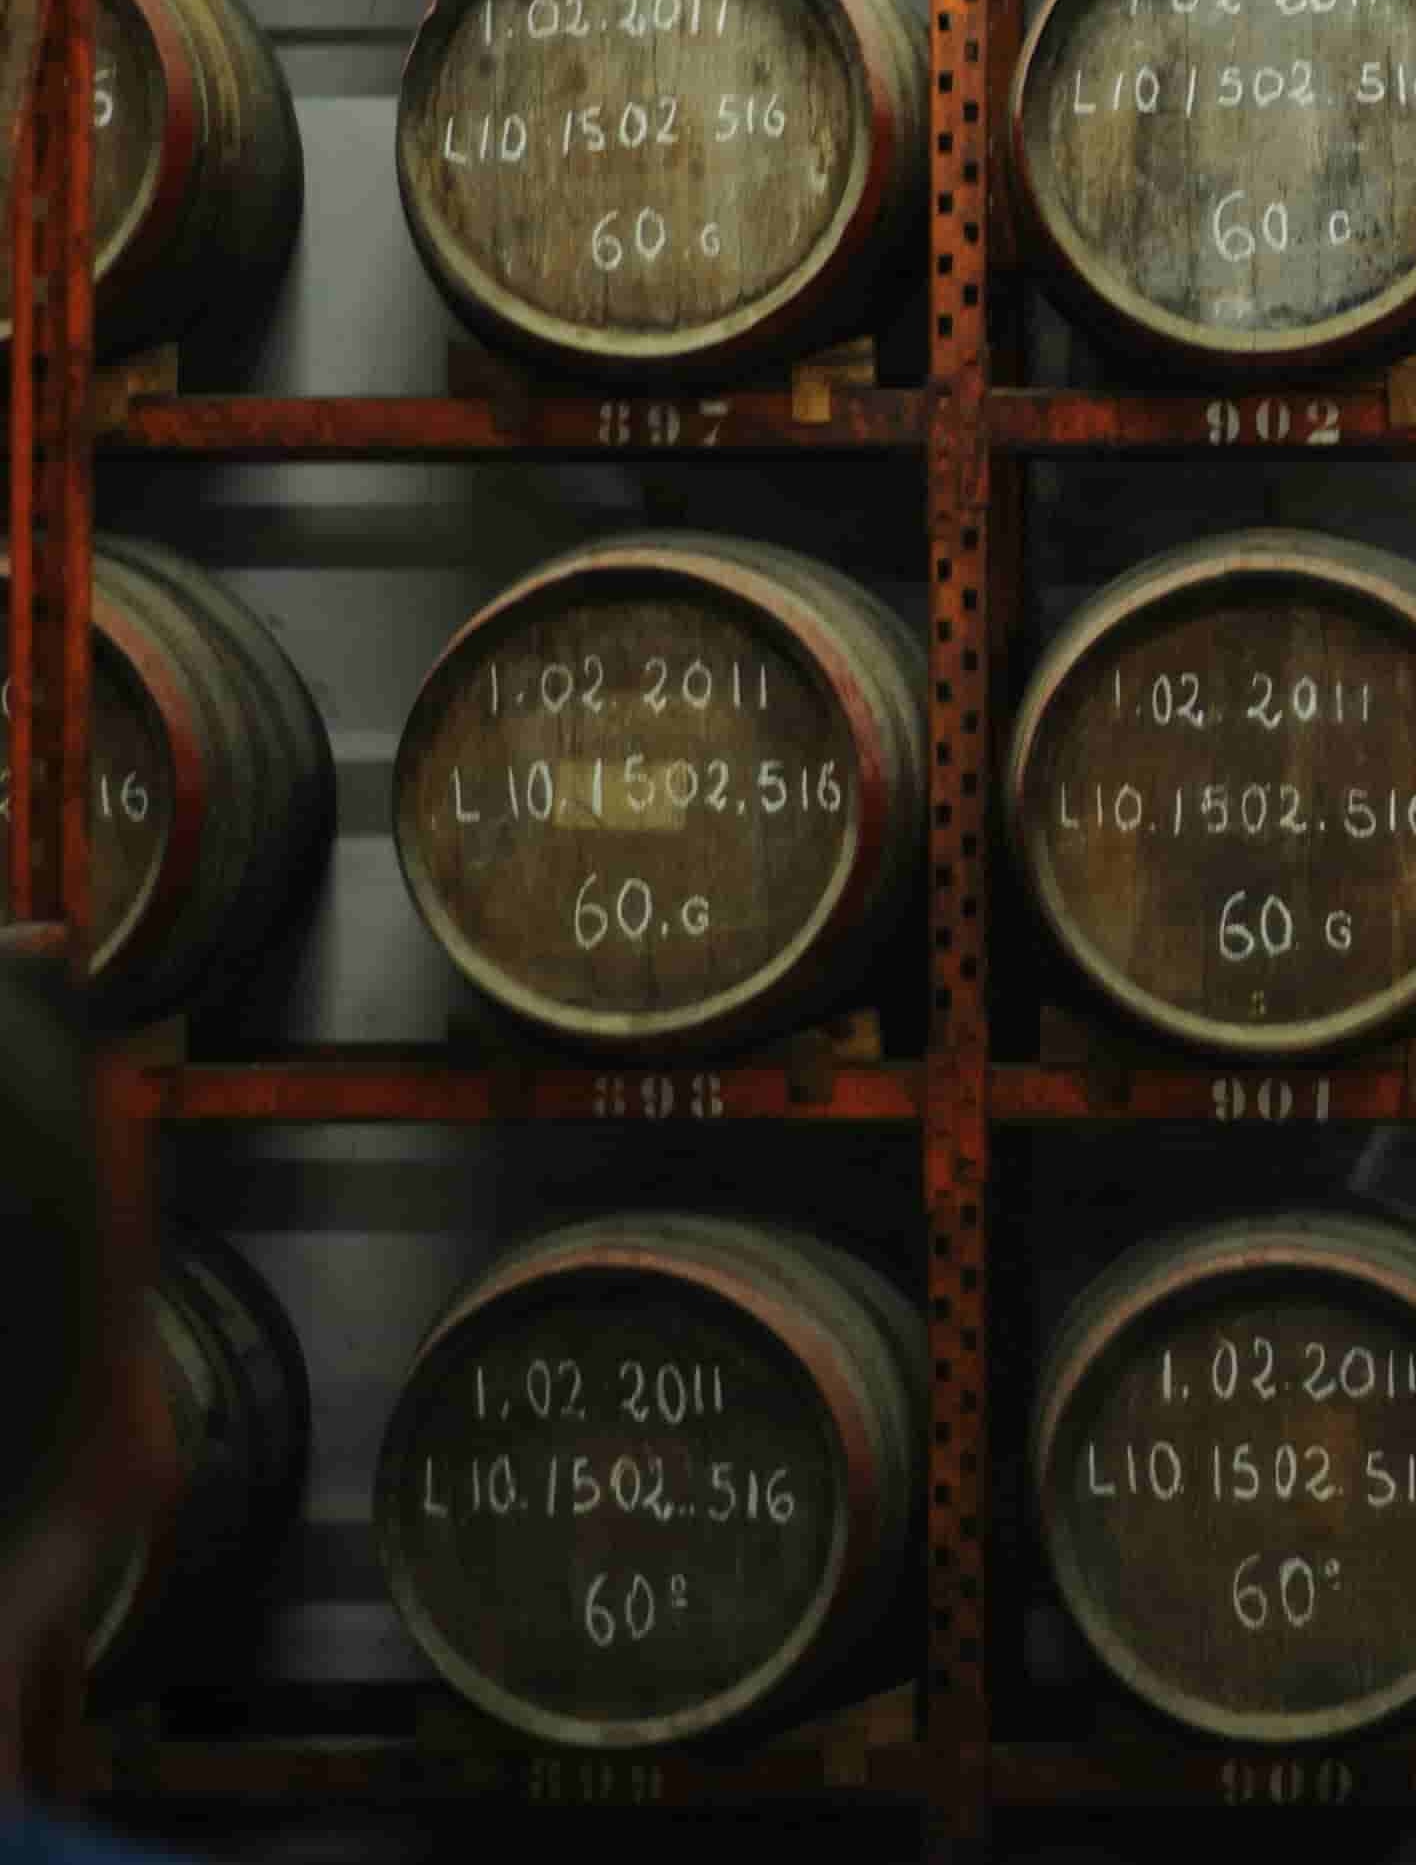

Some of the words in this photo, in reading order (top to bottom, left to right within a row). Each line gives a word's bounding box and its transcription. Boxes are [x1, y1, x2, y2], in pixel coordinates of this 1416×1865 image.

[1211, 188, 1289, 263] 60
[1205, 400, 1340, 446] 902
[1211, 1076, 1330, 1123] 901
